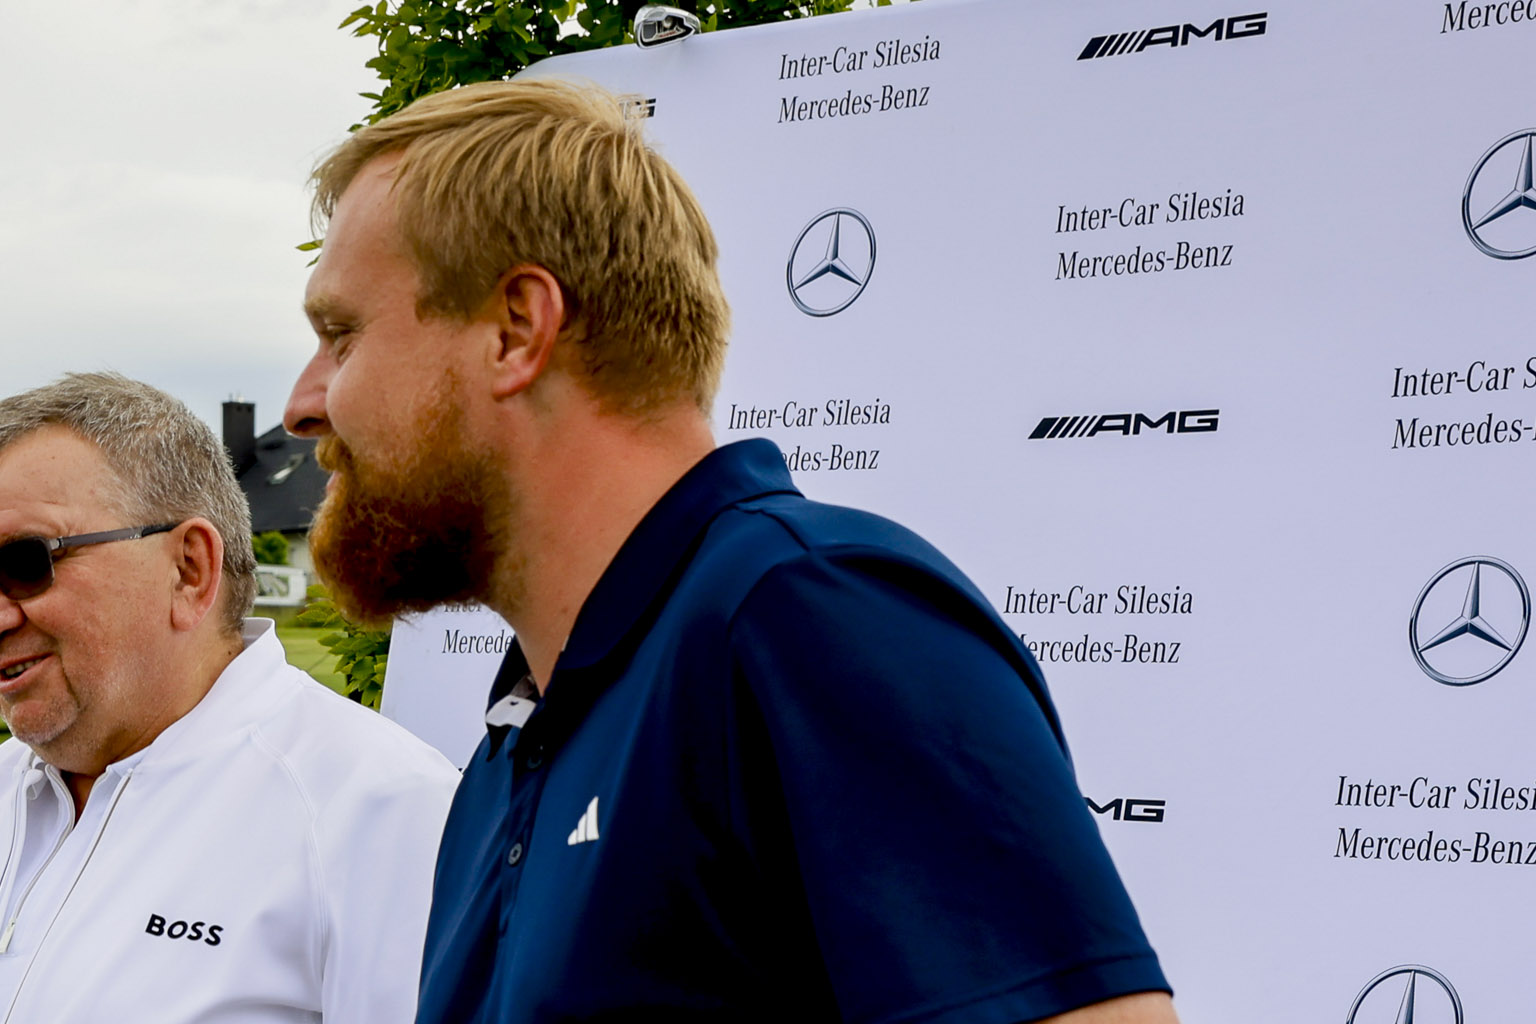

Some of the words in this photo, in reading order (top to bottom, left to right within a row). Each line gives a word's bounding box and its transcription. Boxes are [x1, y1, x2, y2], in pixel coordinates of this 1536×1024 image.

[1135, 12, 1268, 52] AMG
[779, 46, 868, 80] Inter-Car
[873, 35, 940, 68] Silesia
[778, 84, 930, 123] Mercedes-Benz
[1056, 199, 1159, 234] Inter-Car
[1166, 189, 1245, 223] Silesia
[1055, 241, 1234, 280] Mercedes-Benz
[1391, 361, 1515, 398] Inter-Car
[728, 401, 818, 430] Inter-Car
[823, 398, 891, 427] Silesia
[1086, 409, 1220, 438] AMG
[1392, 412, 1536, 449] Mercedes-
[1004, 585, 1108, 614] Inter-Car
[1114, 585, 1193, 614] Silesia
[442, 629, 514, 653] Mercede
[1018, 633, 1181, 663] ercedes-Benz
[1083, 796, 1166, 822] MG
[1335, 776, 1456, 808] Inter-Car
[1333, 828, 1536, 865] Mercedes-Benz
[145, 913, 224, 946] BOSS
